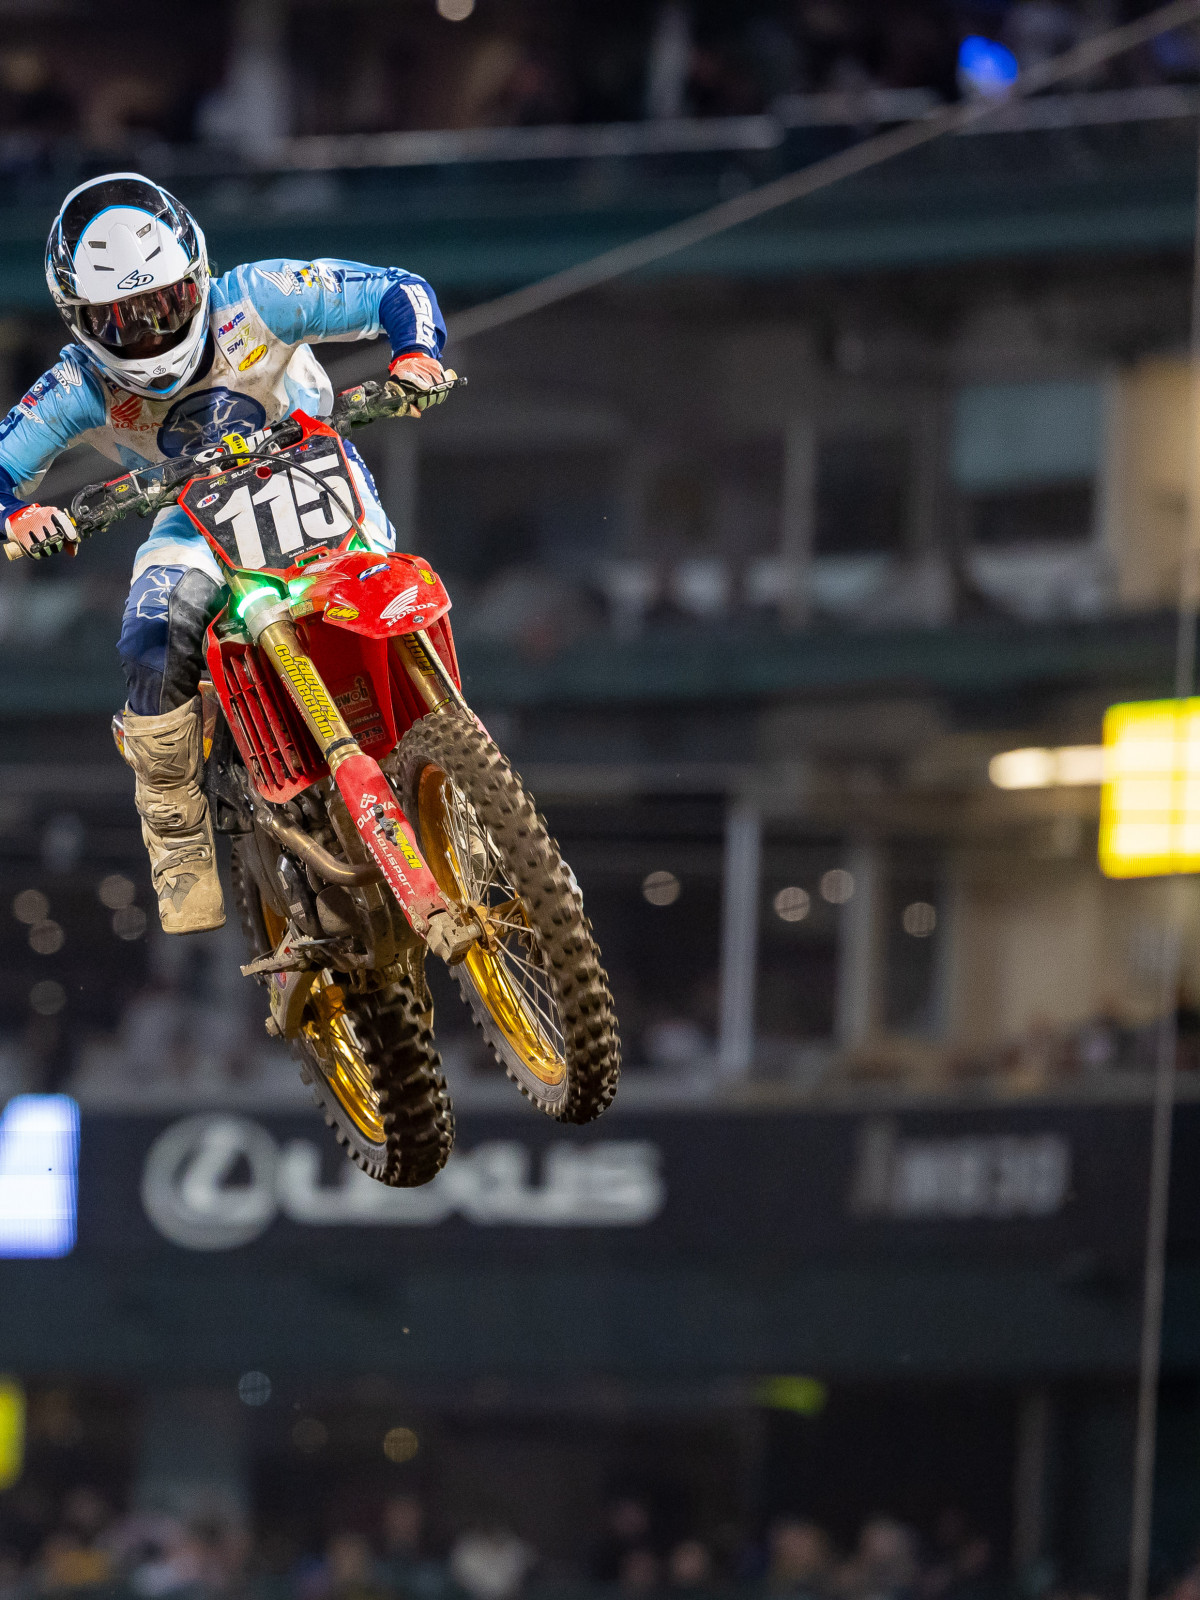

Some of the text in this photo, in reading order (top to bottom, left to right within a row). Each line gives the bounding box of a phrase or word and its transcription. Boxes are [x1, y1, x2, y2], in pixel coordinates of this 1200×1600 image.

[213, 453, 355, 570] 115
[386, 602, 438, 627] HONDA
[366, 841, 408, 911] DUNLOP
